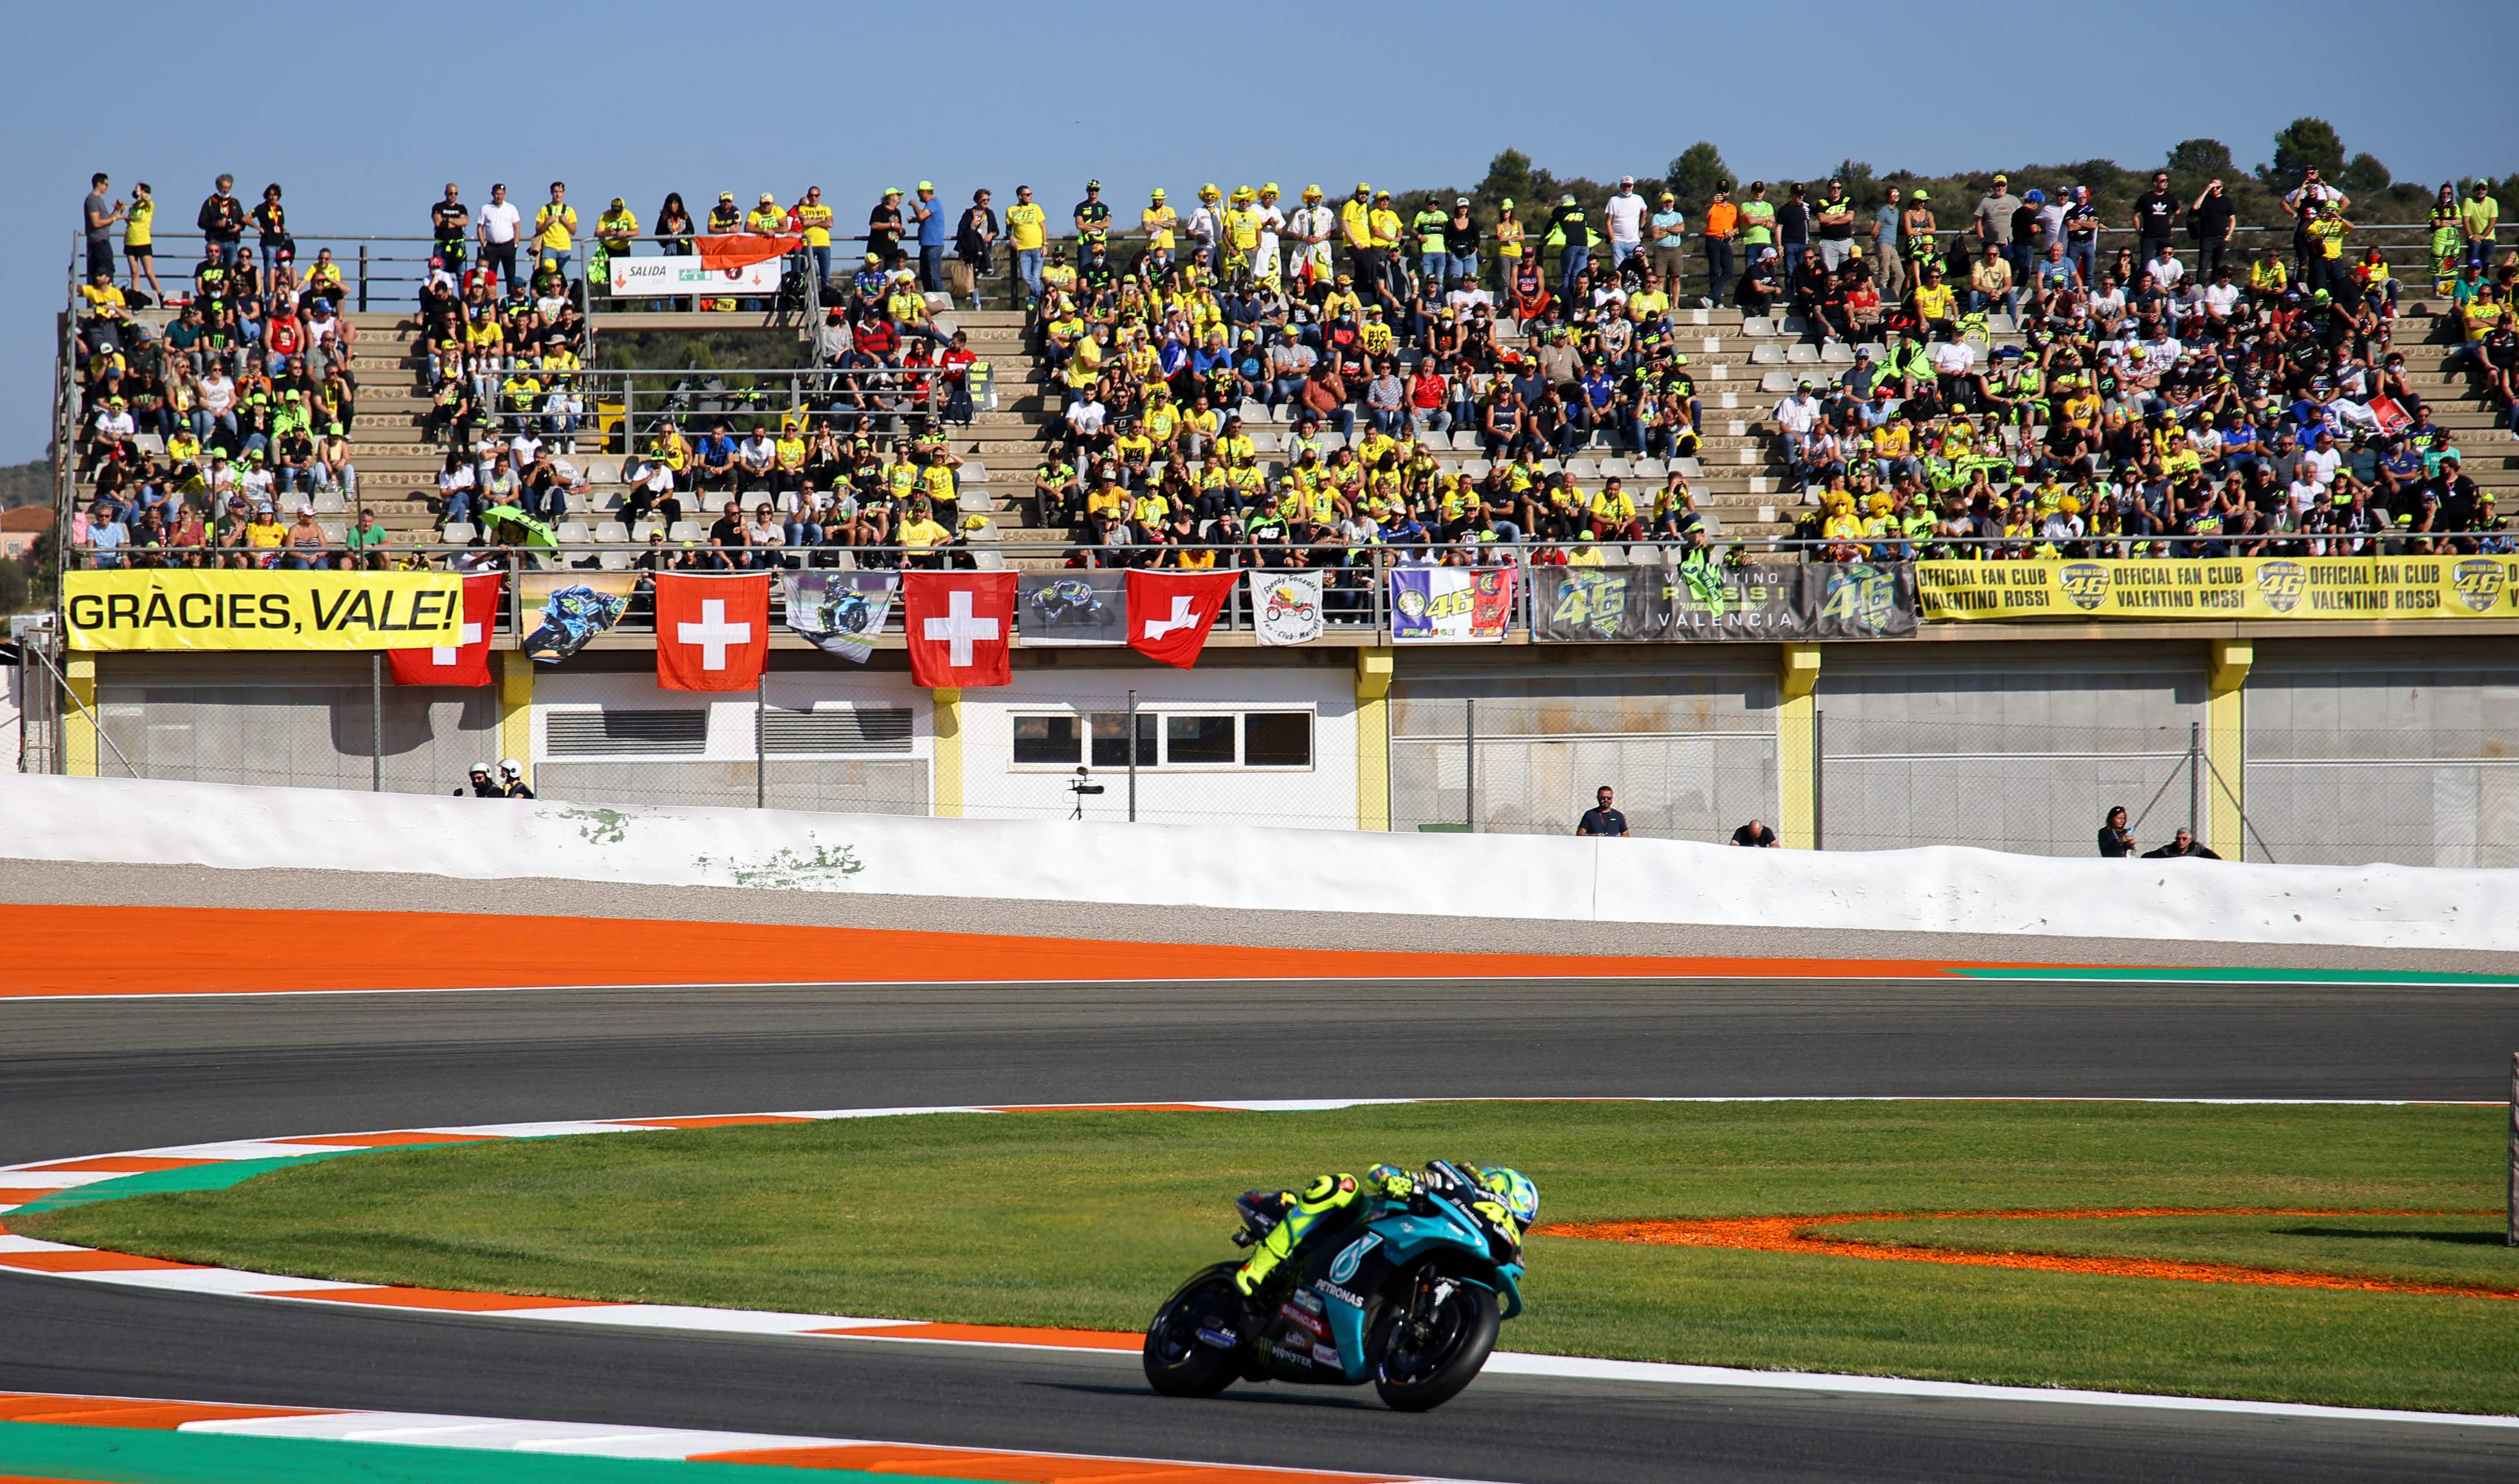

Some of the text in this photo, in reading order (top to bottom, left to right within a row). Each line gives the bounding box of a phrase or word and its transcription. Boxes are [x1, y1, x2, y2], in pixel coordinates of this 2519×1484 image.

[1565, 212, 1584, 222] 46
[1825, 205, 1846, 214] 46
[202, 269, 224, 281] 46
[629, 266, 666, 277] SALIDA
[1962, 312, 1984, 322] 46
[2474, 308, 2496, 319] 46
[1645, 334, 1659, 344] 46
[969, 362, 989, 372] 46
[970, 373, 988, 381] THANK
[970, 383, 982, 392] YOU
[971, 394, 985, 402] VALE
[2412, 435, 2434, 446] 46
[518, 514, 543, 531] 46
[1258, 527, 1280, 539] 46
[1918, 568, 2047, 587] OFFICIAL FAN CLUB
[2114, 566, 2244, 585] OFFICIAL FAN CLUB
[2310, 564, 2440, 585] OFFICIAL FAN CLUB
[1264, 574, 1318, 595] Speedy Gonzales
[2061, 576, 2111, 595] 46
[2257, 573, 2307, 596] 46
[2453, 573, 2505, 595] 46
[1553, 577, 1628, 625] 46
[1662, 587, 1785, 600] RSSI
[1822, 573, 1896, 620] 46
[1922, 590, 2050, 611] VALENTINO ROSSI
[2117, 589, 2245, 609] VALENTINO ROSSI
[2311, 588, 2442, 610] VALENTINO ROSSI
[70, 585, 457, 635] GRÀCIES, VALE!
[1425, 587, 1476, 620] 46
[1658, 613, 1792, 627] VALENCIA
[1402, 627, 1504, 636] FRANCE FANS
[1315, 1278, 1364, 1308] PETRONAS
[1272, 1344, 1312, 1367] MONSTER
